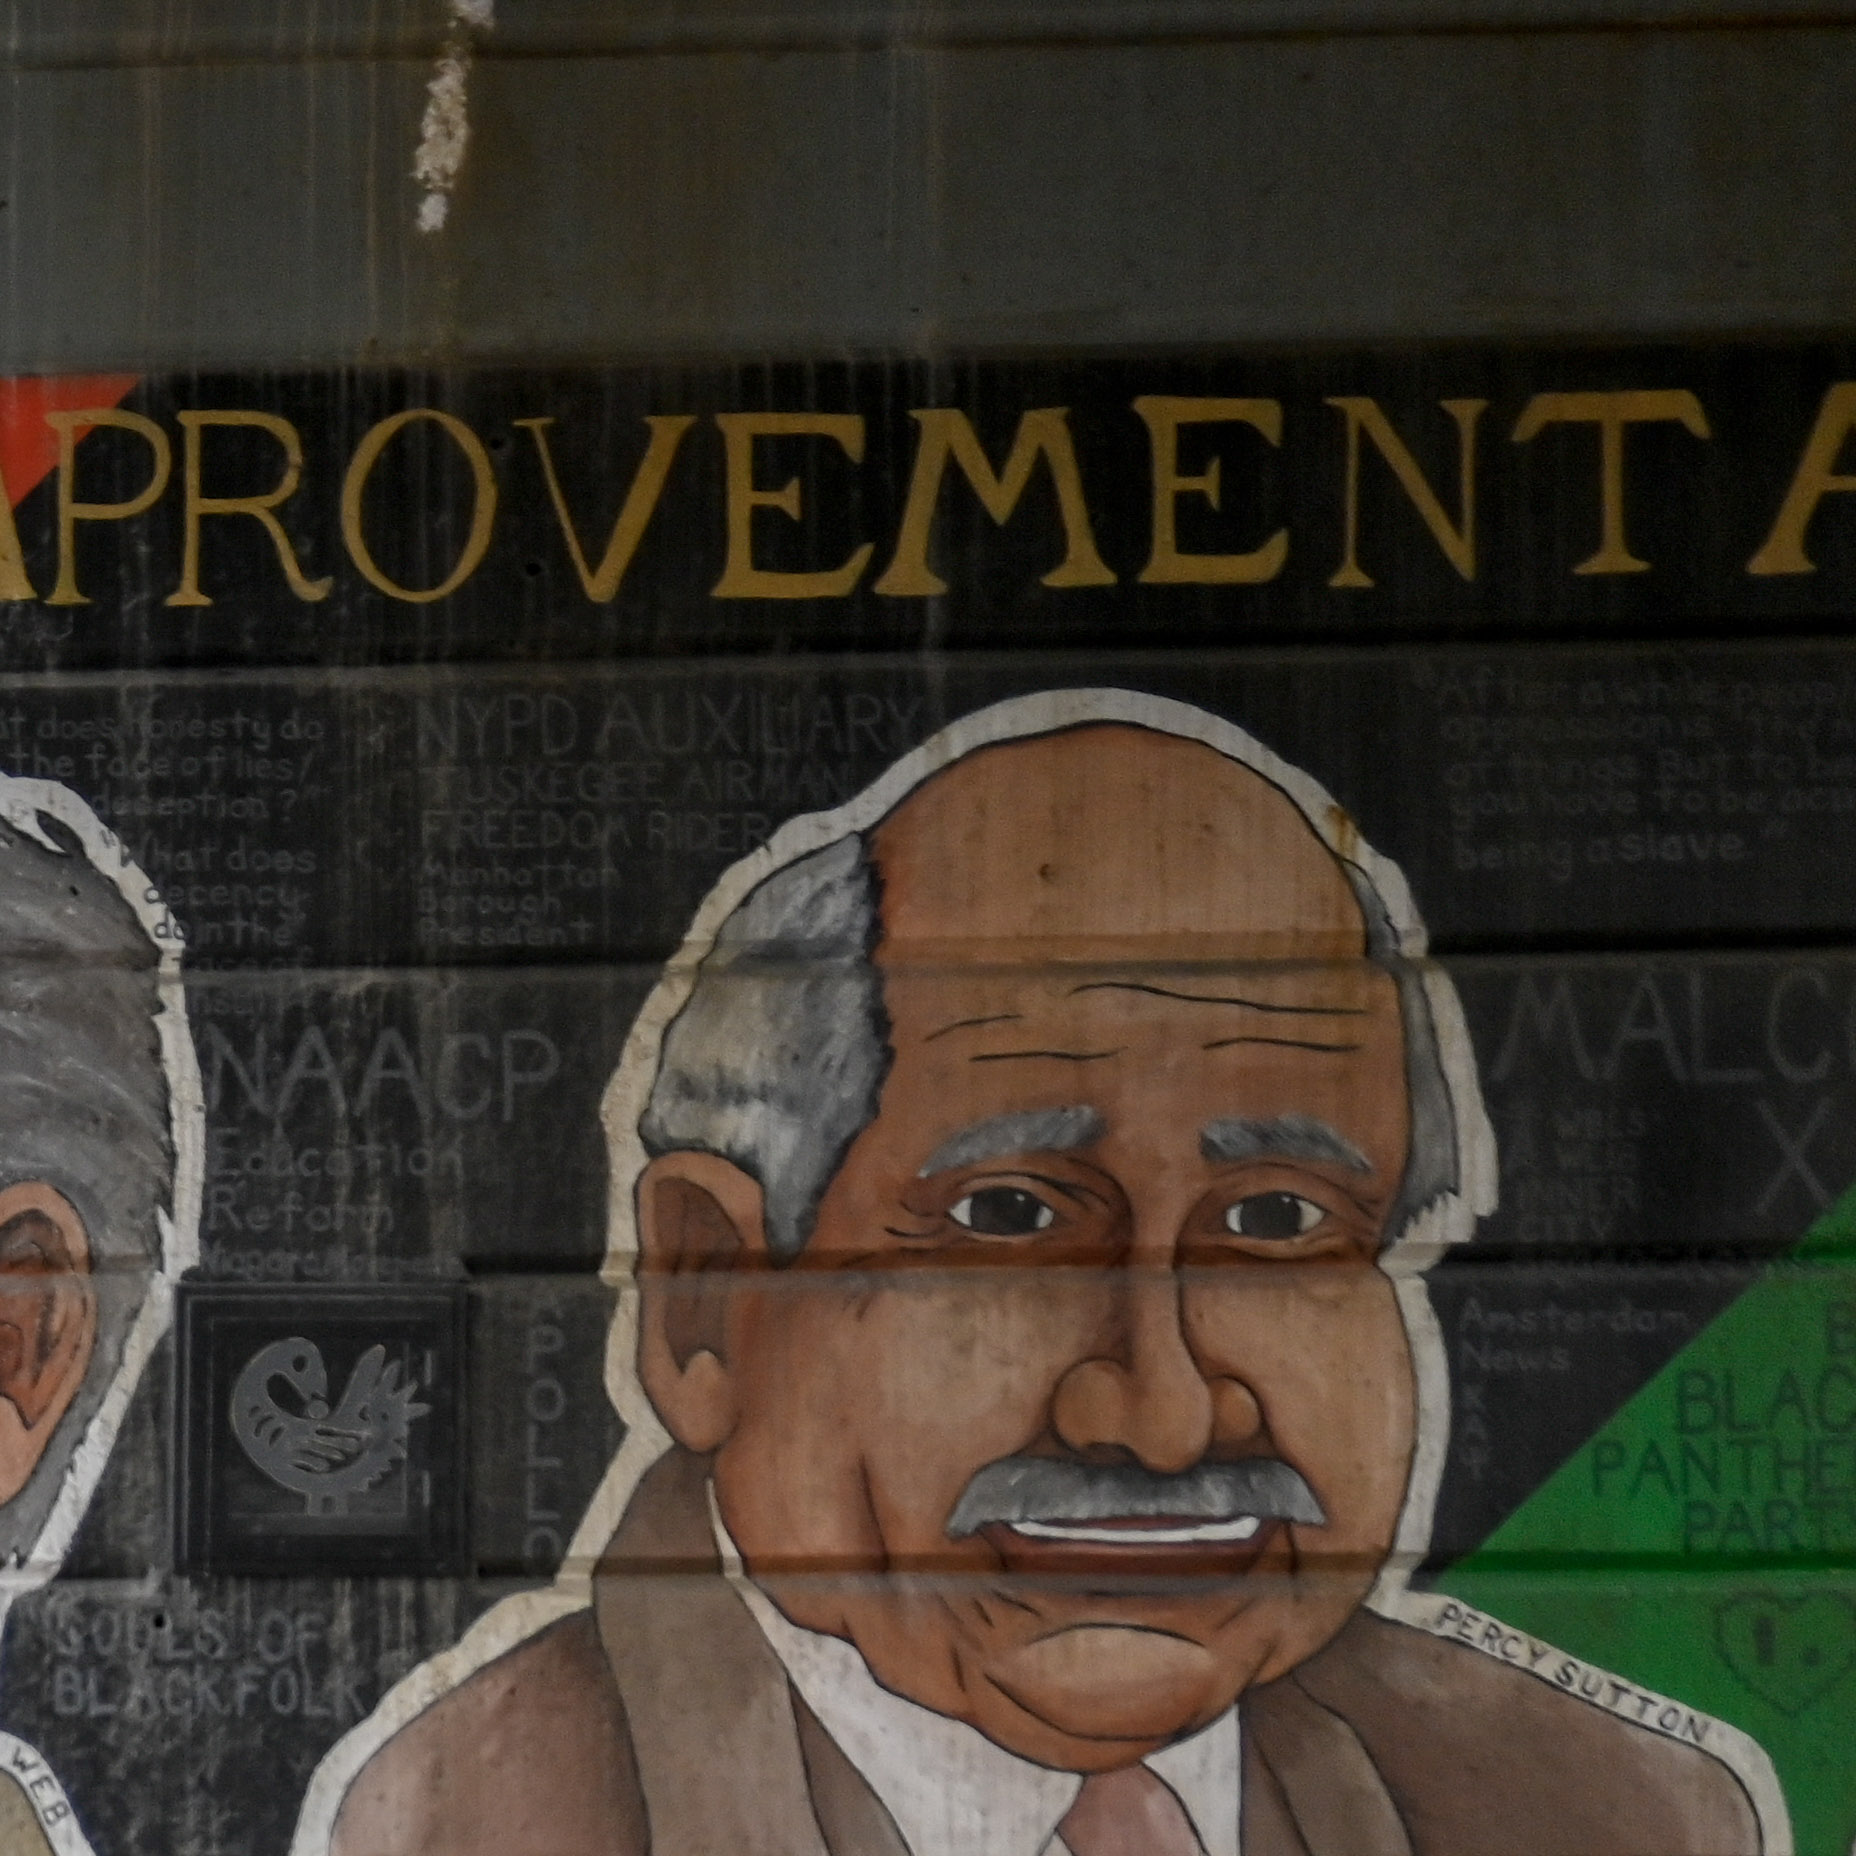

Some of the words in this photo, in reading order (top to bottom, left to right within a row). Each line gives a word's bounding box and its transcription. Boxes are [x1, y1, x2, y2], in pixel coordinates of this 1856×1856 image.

[417, 693, 578, 759] NYPD
[647, 808, 772, 854] RIDER
[1491, 965, 1856, 1084] MALC
[205, 1022, 563, 1124] NAACP
[1751, 1097, 1839, 1216] X
[1589, 1437, 1856, 1497] PANTHE
[1684, 1499, 1856, 1551] PART
[1438, 1602, 1550, 1665] PERCY
[1554, 1660, 1713, 1743] SUTTON
